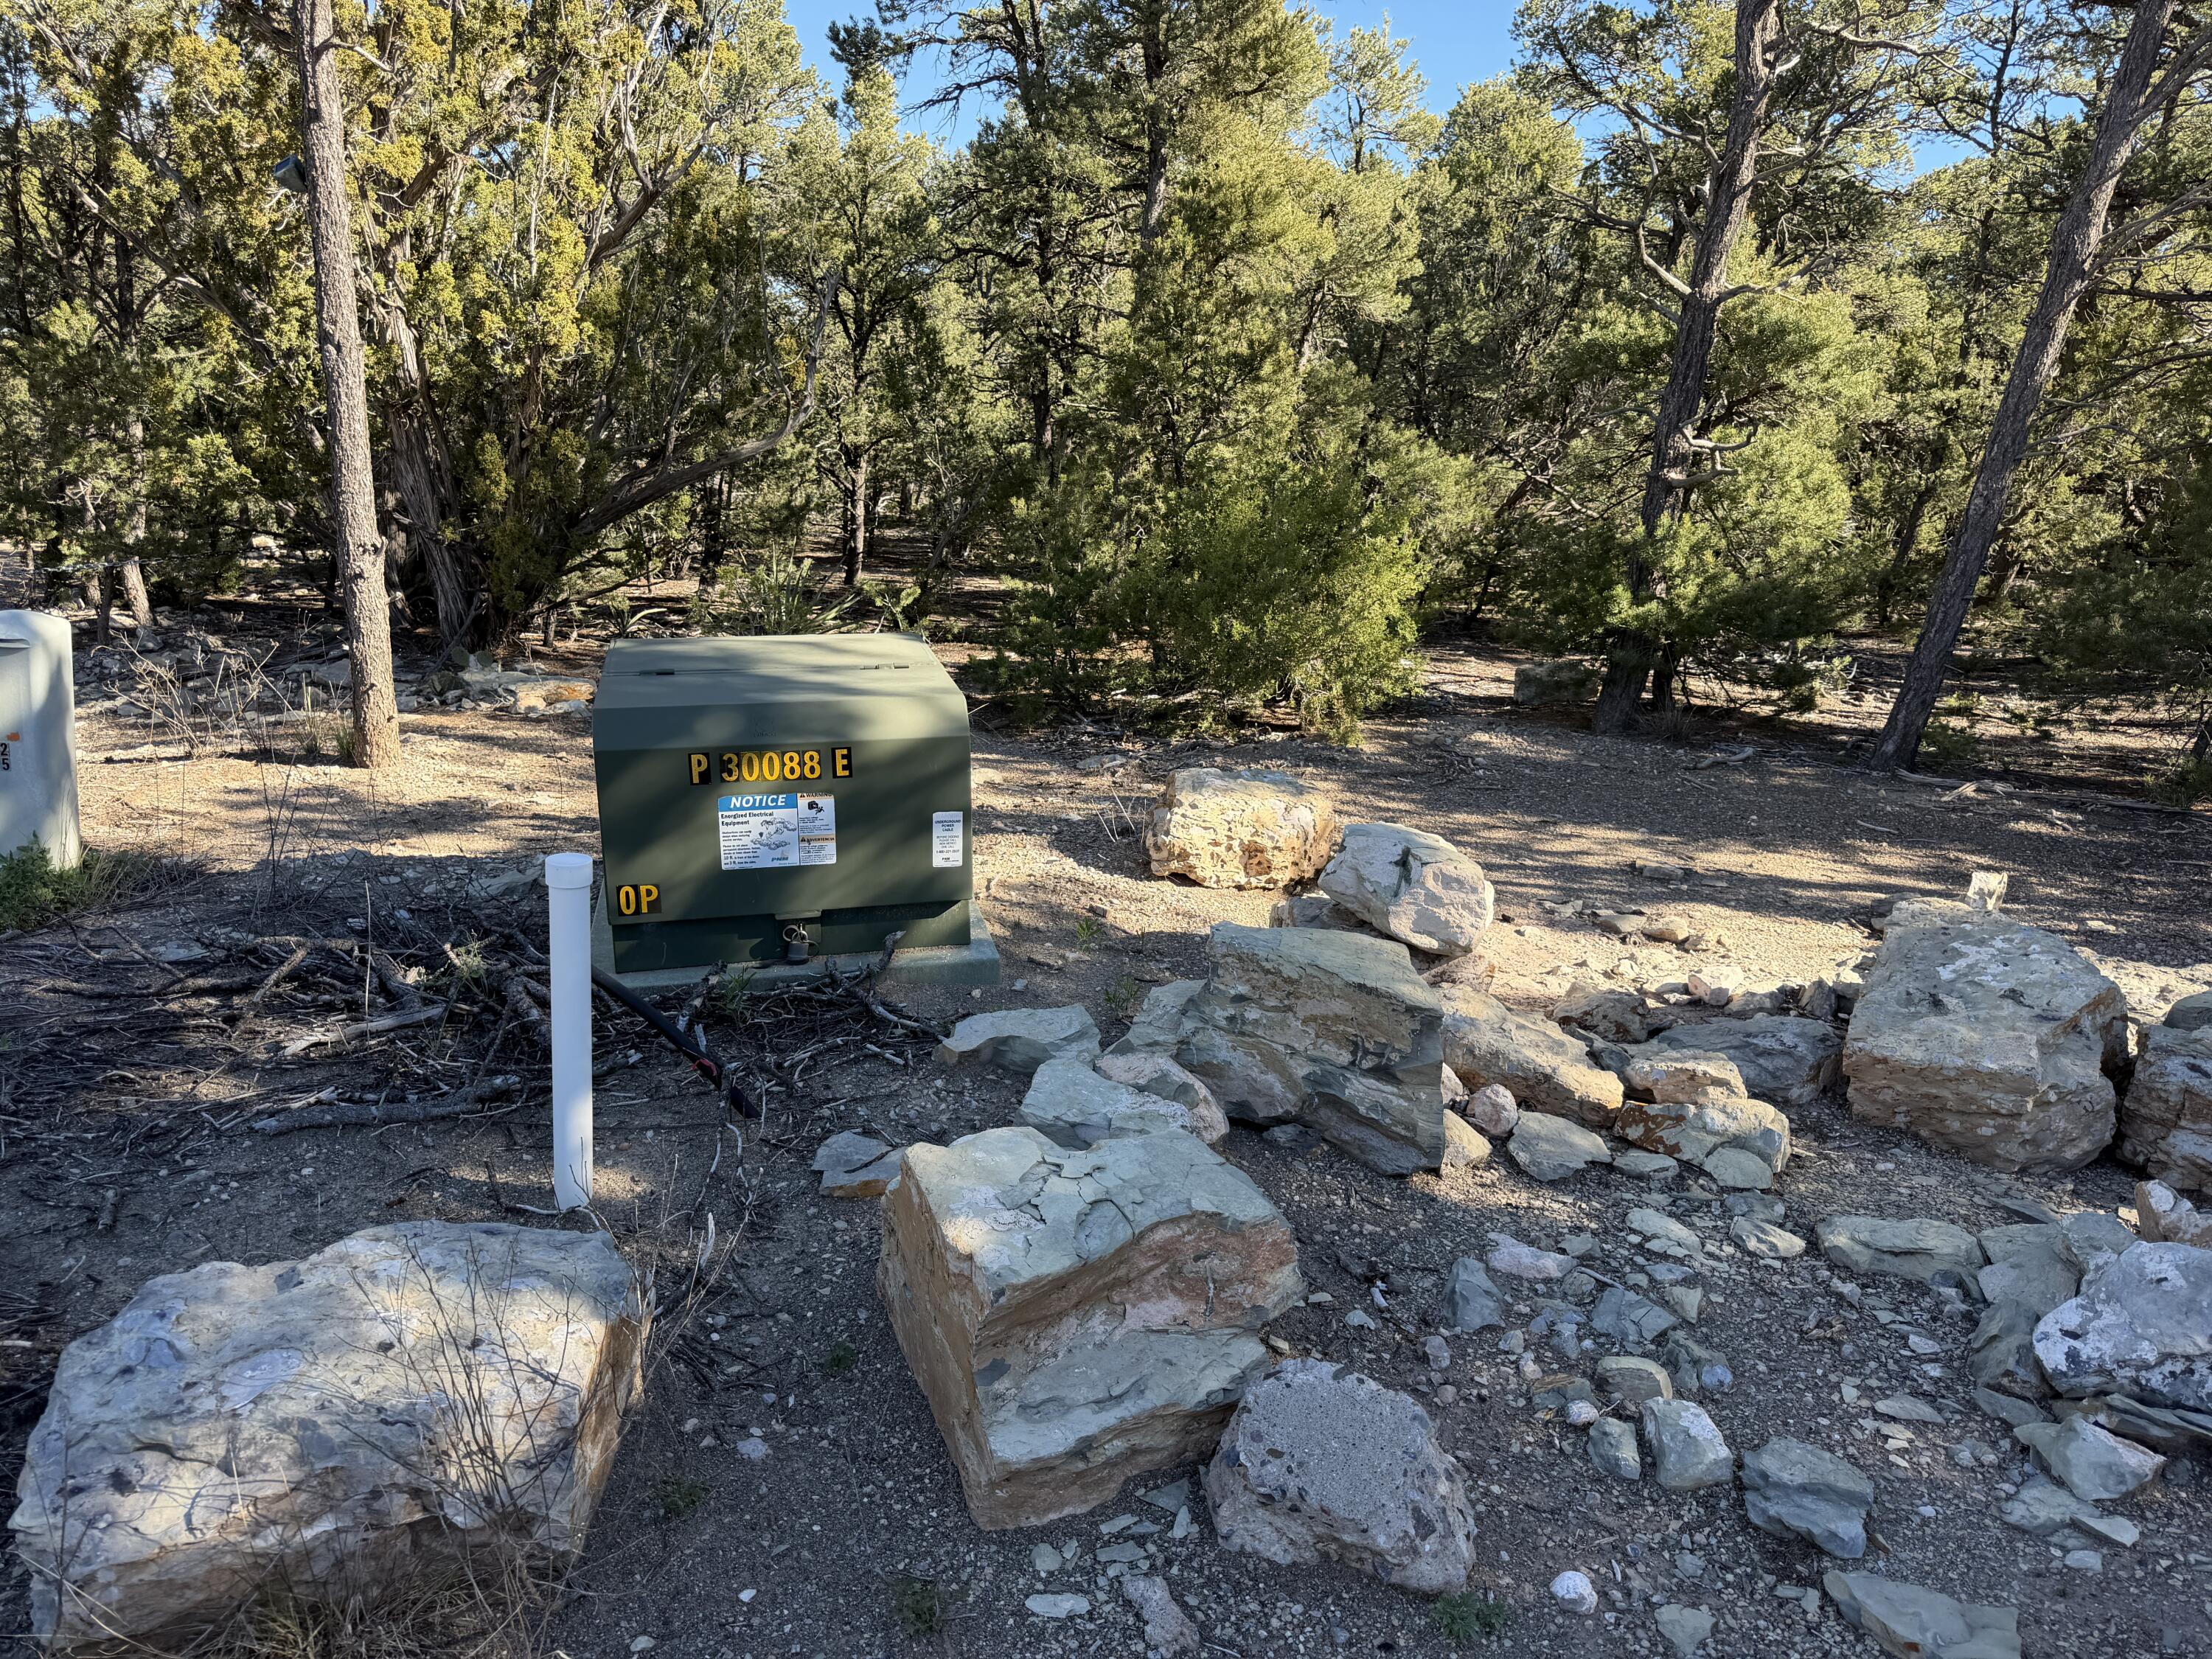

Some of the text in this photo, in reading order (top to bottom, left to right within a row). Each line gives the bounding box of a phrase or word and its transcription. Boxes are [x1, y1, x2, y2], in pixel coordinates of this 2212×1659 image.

[0, 742, 8, 756] 2
[2, 757, 10, 771] 5
[691, 748, 849, 784] P 30088 E
[730, 794, 787, 809] NOTICE
